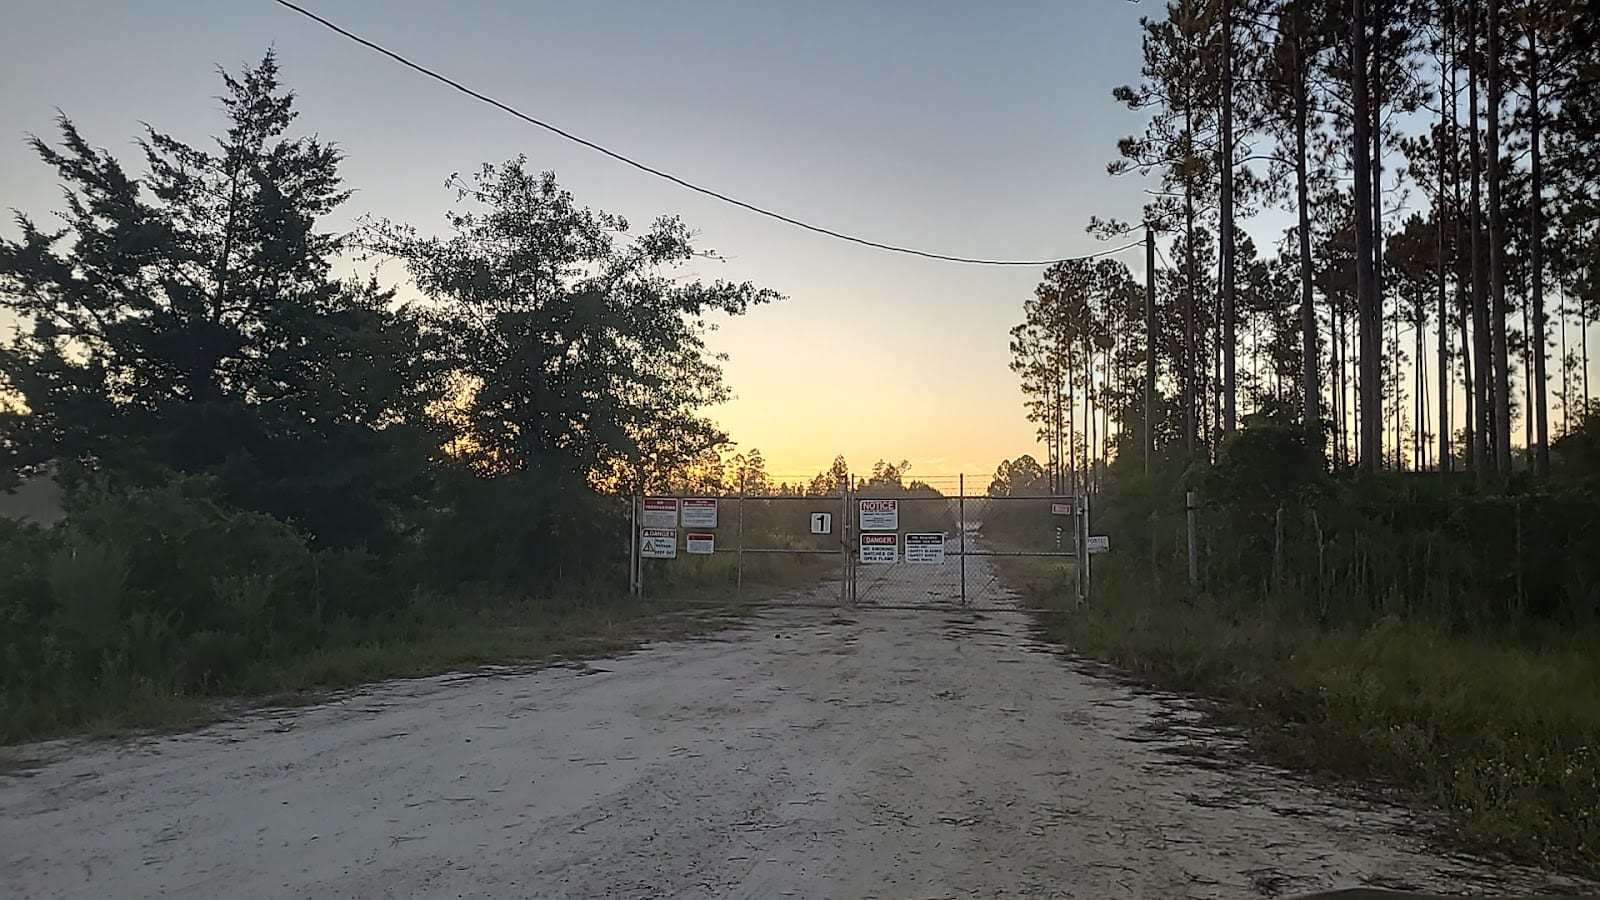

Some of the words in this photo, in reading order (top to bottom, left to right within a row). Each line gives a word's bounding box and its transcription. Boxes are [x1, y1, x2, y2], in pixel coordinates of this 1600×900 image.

[863, 501, 894, 510] NOTICE
[816, 514, 825, 532] 1
[866, 536, 892, 545] DANGER
